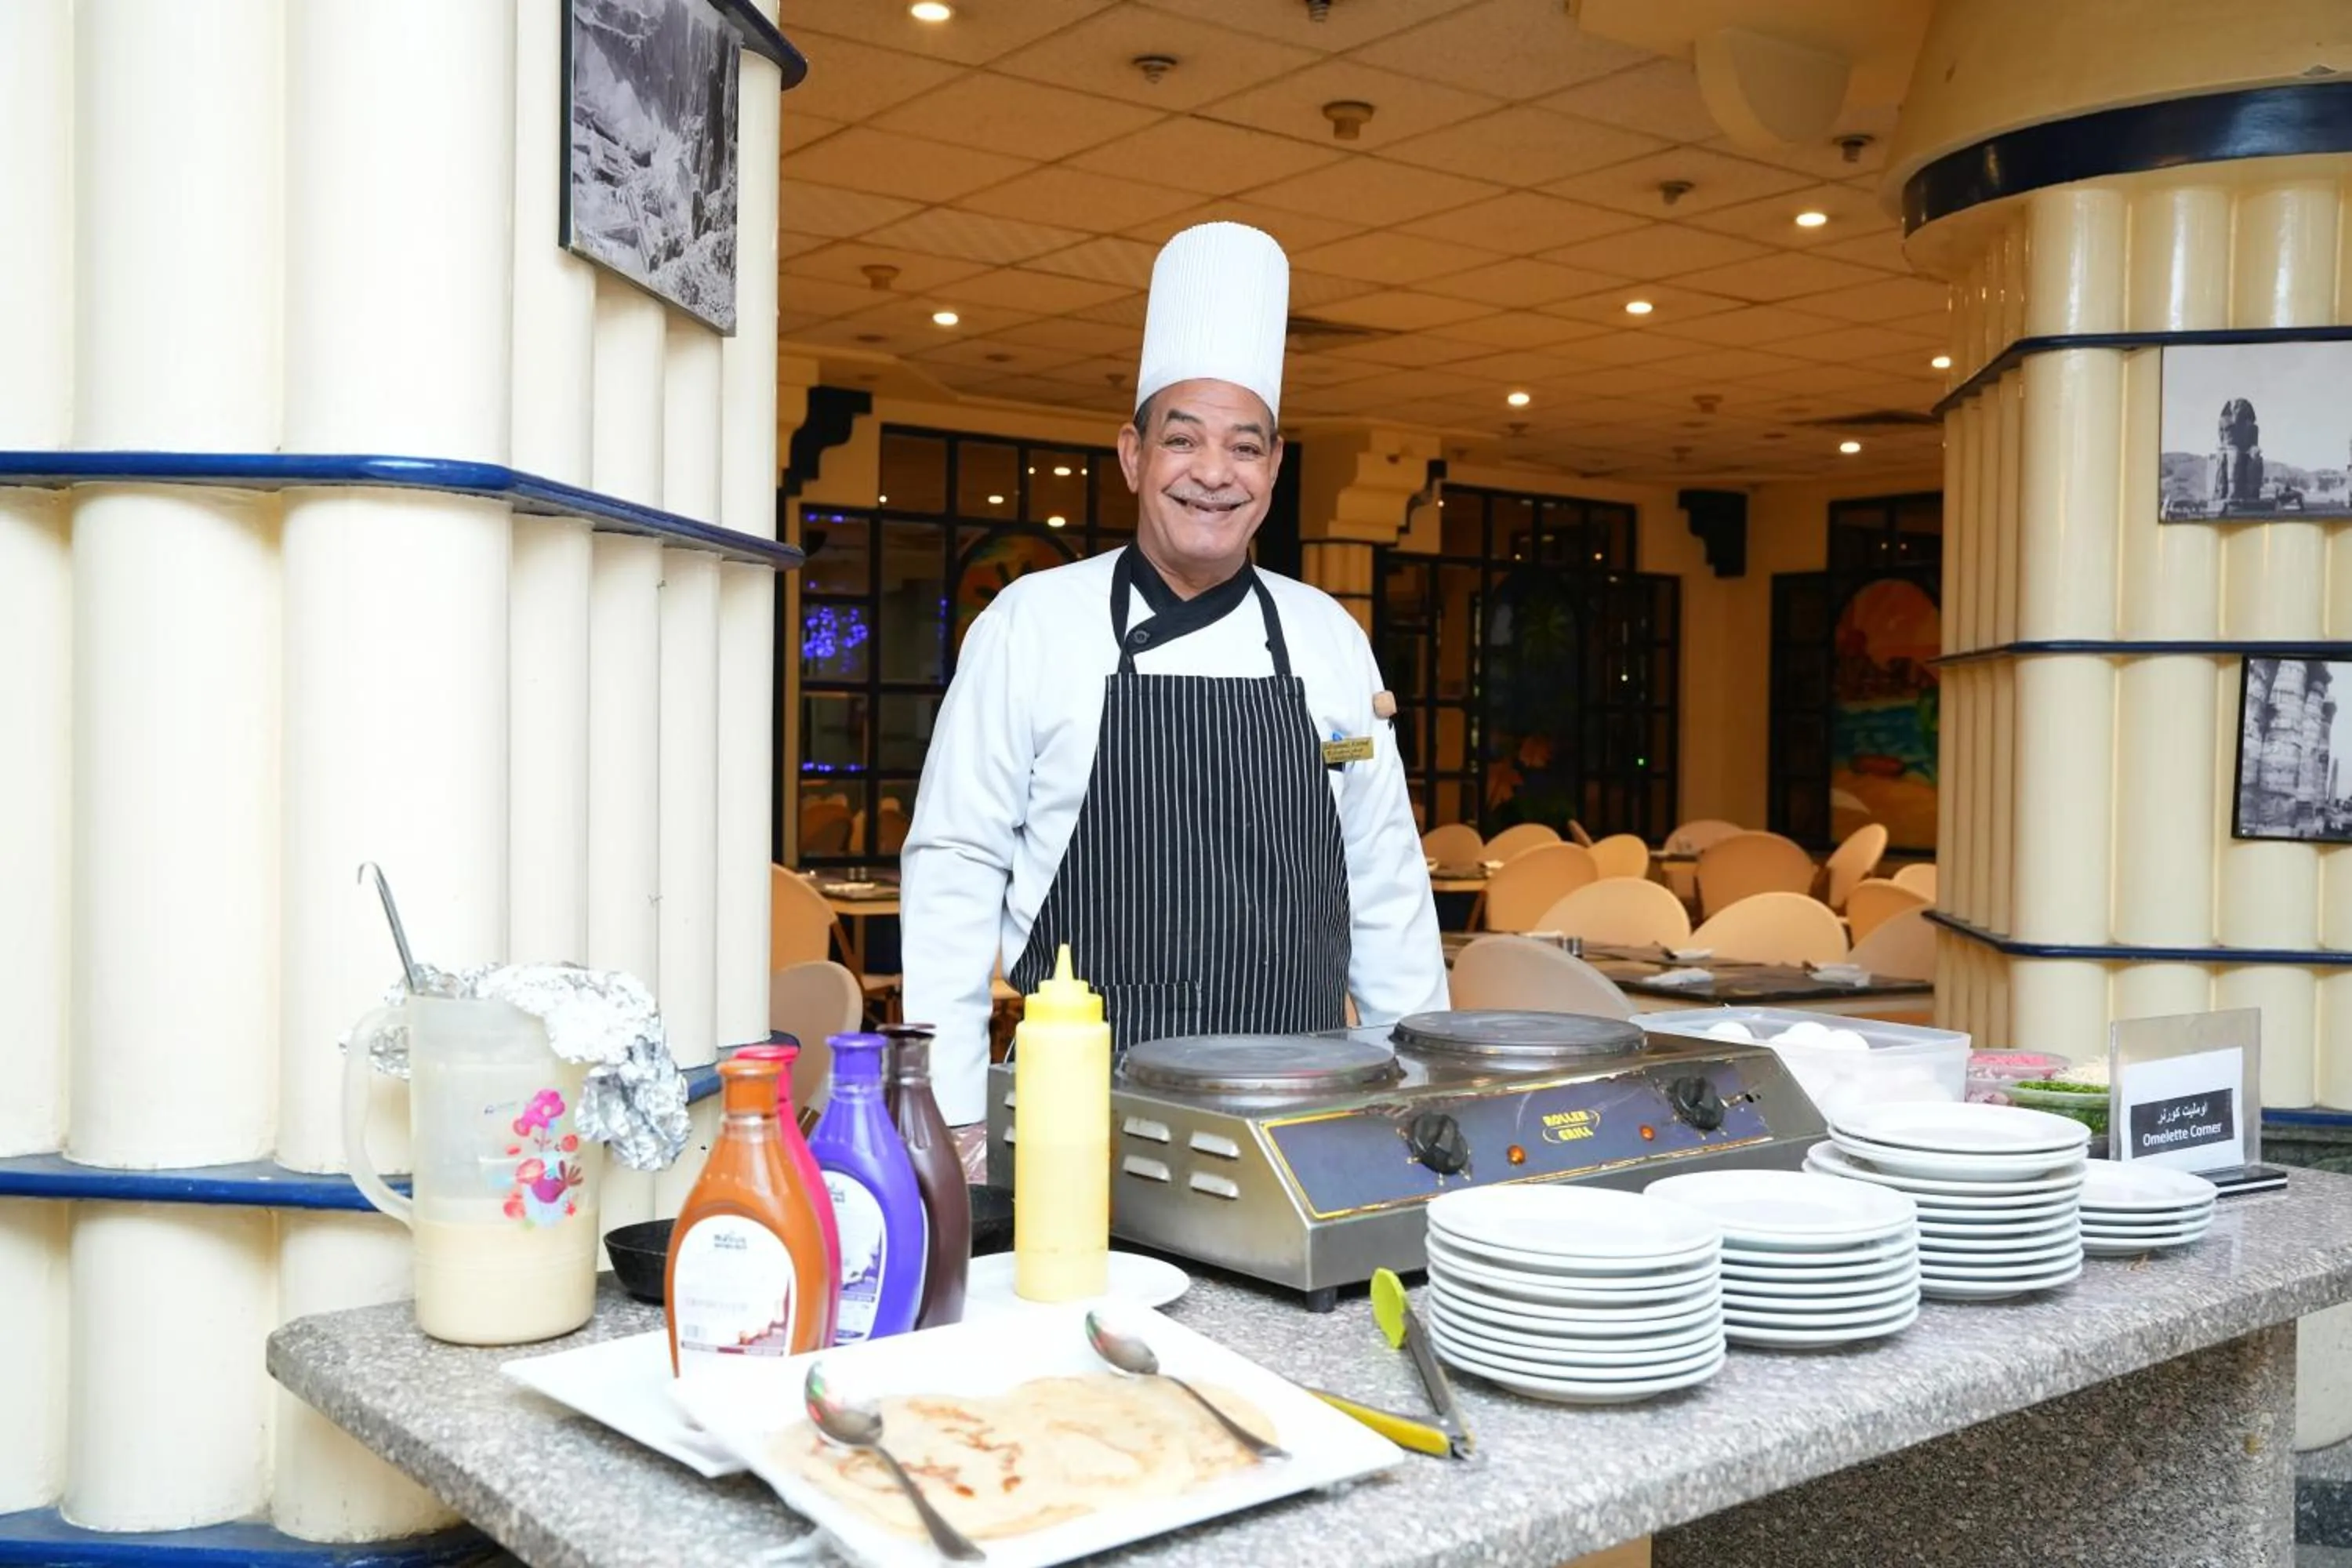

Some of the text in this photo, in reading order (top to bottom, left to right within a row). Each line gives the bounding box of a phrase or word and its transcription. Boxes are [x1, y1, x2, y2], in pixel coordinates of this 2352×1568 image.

[1542, 1111, 1589, 1127] ROLLER
[1558, 1126, 1594, 1141] GRILL
[2143, 1123, 2222, 1147] Omelette Corner
